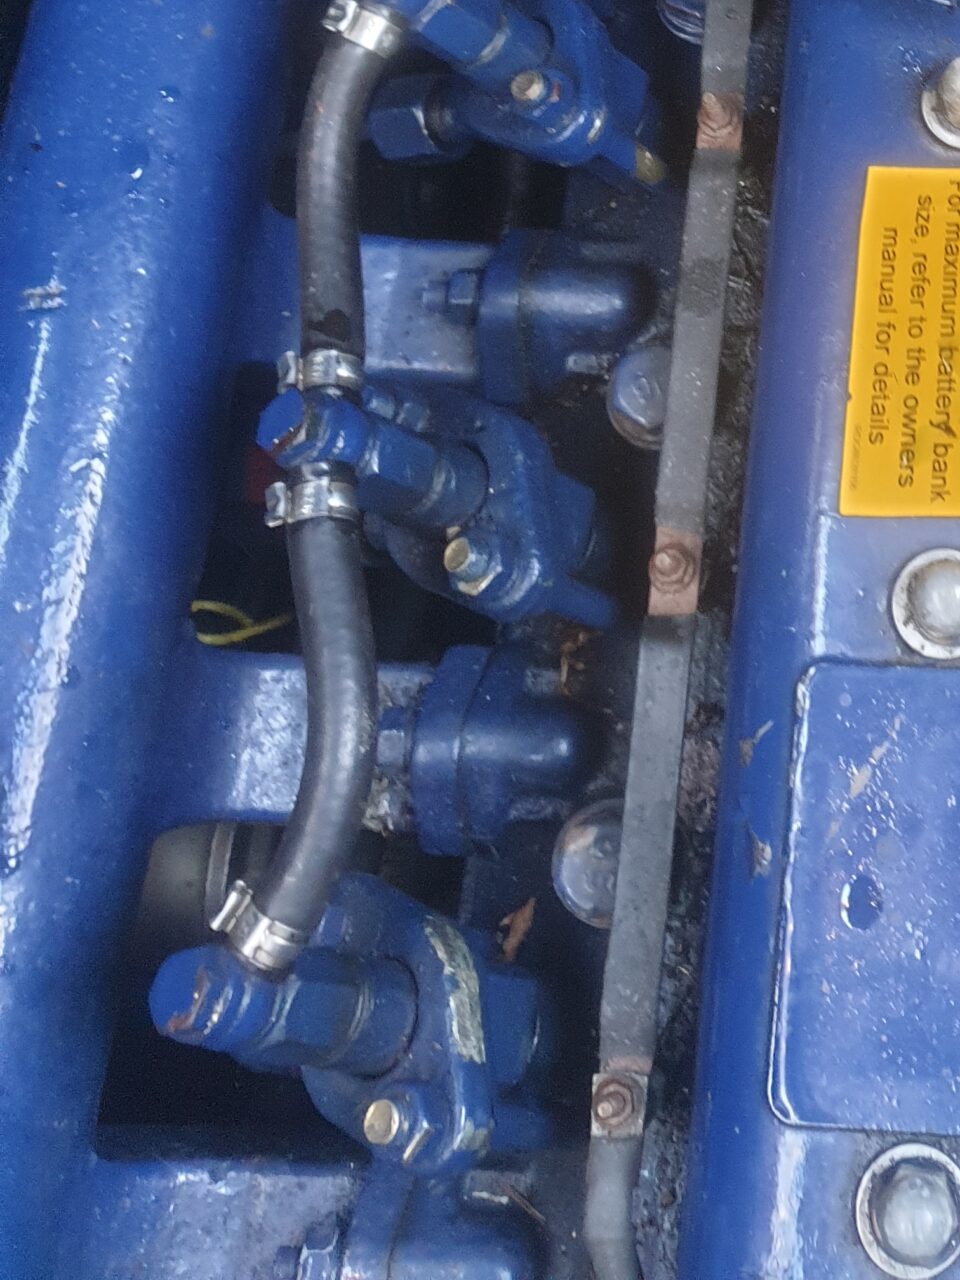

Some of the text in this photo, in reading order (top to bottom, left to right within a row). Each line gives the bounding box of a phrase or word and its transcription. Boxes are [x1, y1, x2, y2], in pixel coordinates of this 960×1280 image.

[910, 252, 931, 309] refer
[868, 227, 900, 445] manual for details
[906, 317, 928, 339] to
[903, 348, 927, 385] the
[929, 345, 959, 435] battery
[898, 395, 920, 488] owners
[929, 443, 954, 502] bank
